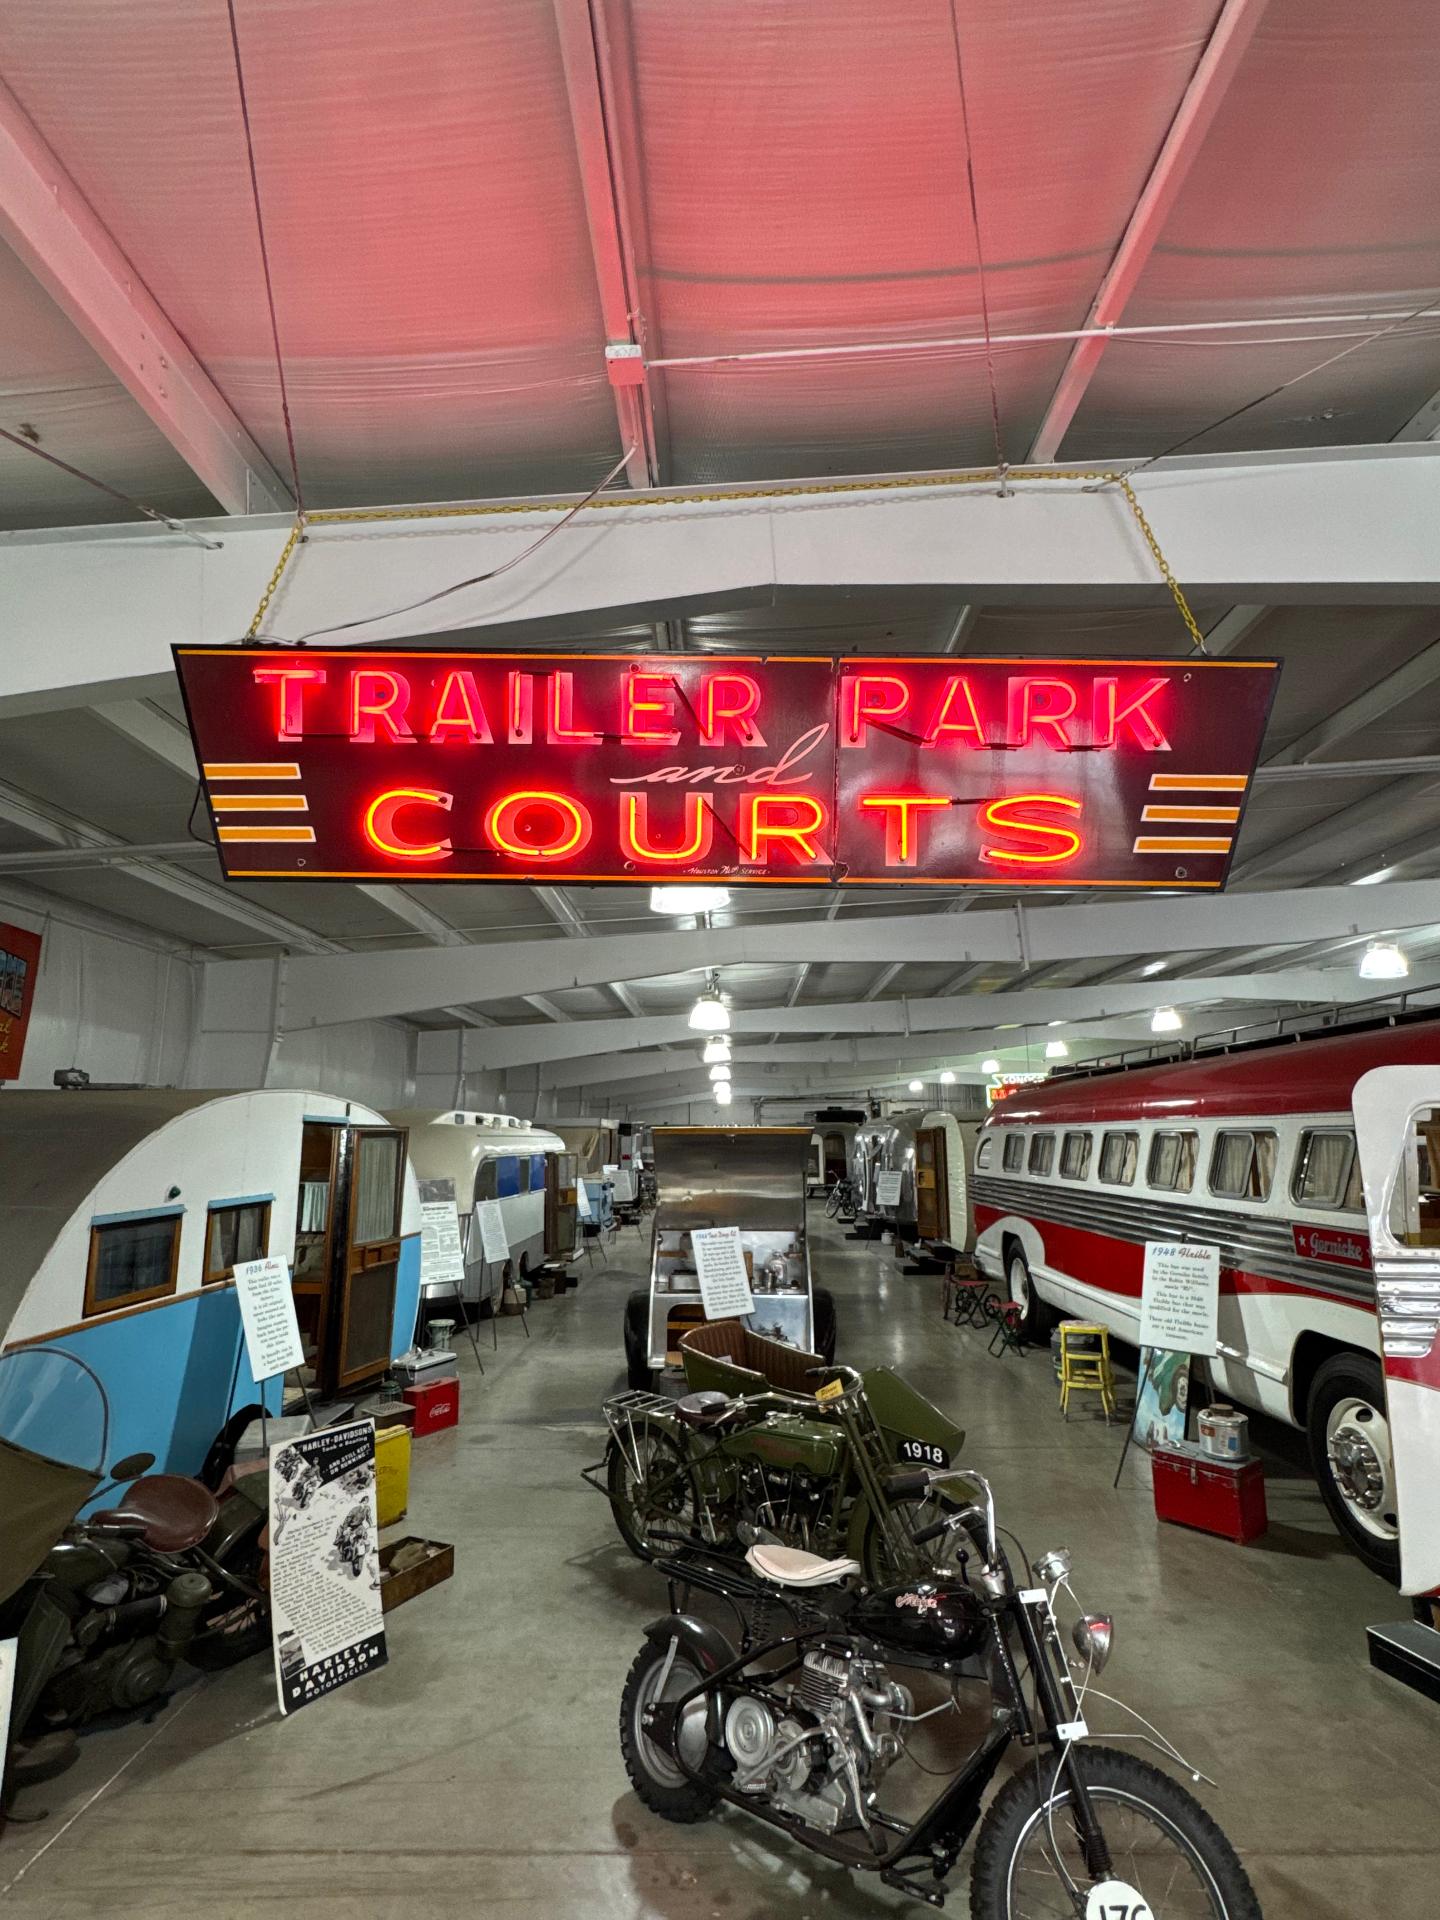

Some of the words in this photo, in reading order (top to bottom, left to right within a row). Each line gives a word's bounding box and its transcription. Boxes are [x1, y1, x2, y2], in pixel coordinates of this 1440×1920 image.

[253, 667, 768, 748] TRAILER
[840, 675, 1172, 751] PARK
[610, 722, 830, 786] and
[364, 787, 1084, 868] COURTS
[1152, 1246, 1177, 1257] 1948
[903, 1442, 943, 1463] 1918
[292, 1646, 379, 1698] DAVIDSON
[305, 1662, 369, 1699] MOTORCYCLES
